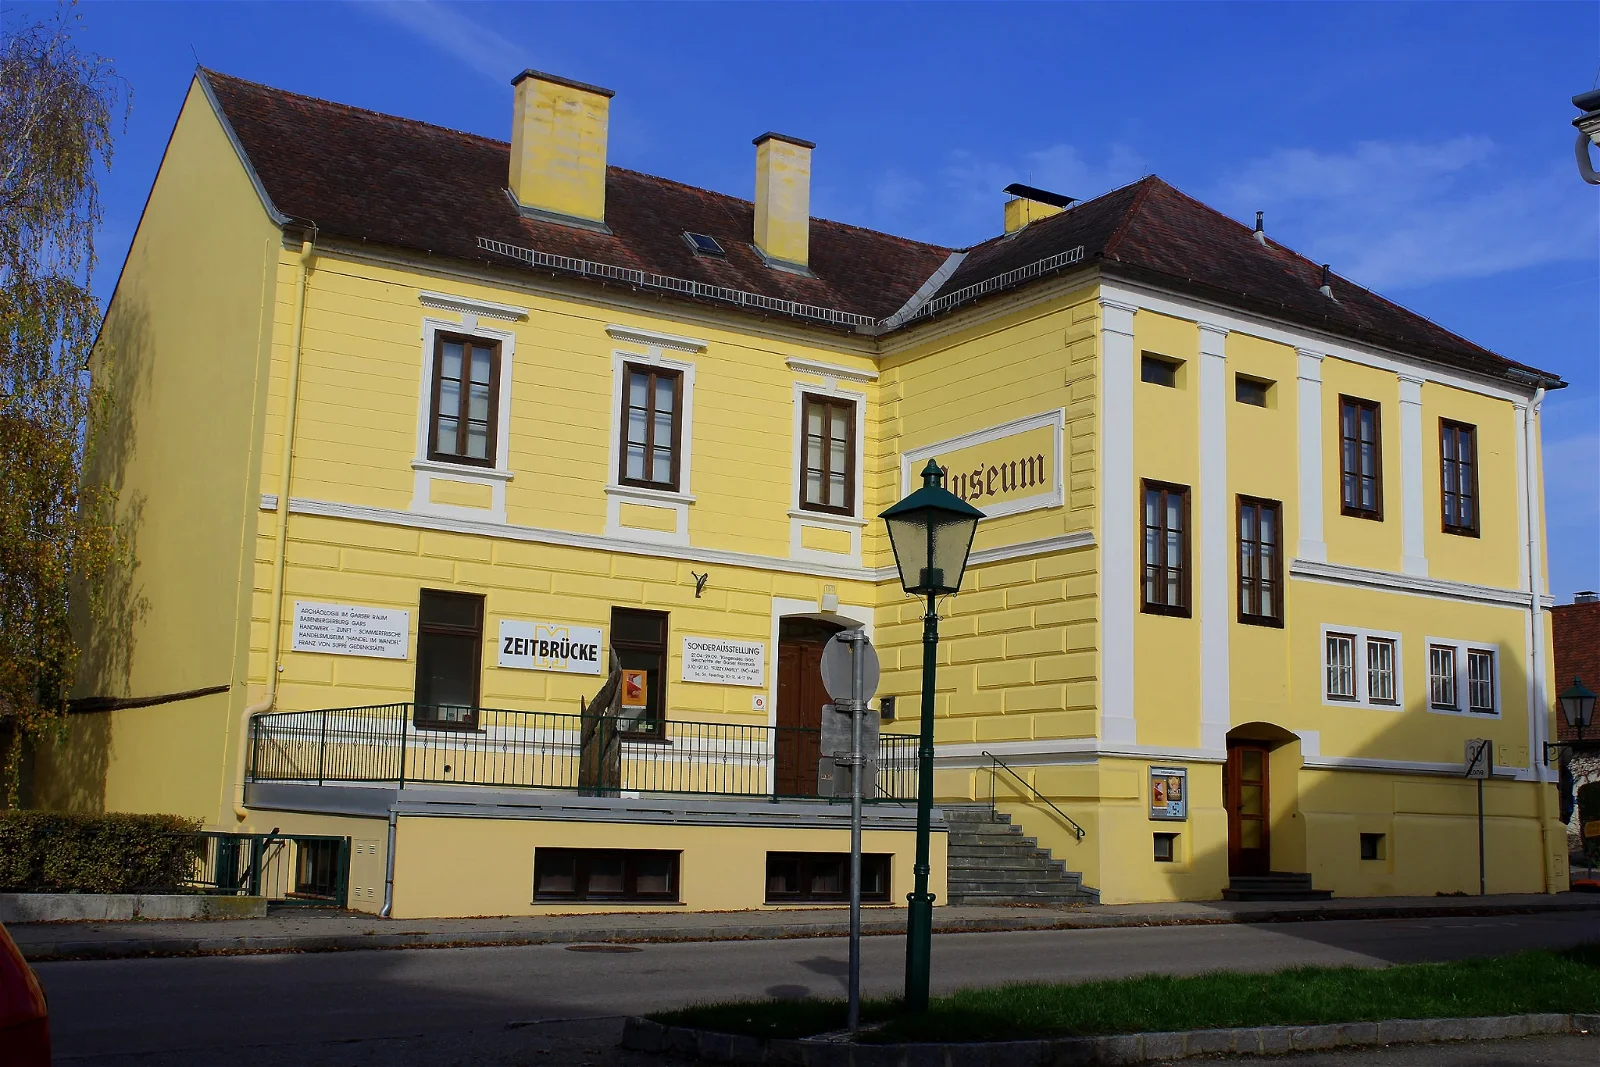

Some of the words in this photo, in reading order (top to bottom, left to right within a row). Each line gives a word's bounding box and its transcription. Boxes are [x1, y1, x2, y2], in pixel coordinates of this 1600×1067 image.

[941, 453, 1045, 501] useum
[504, 637, 598, 661] ZEITBRÜCKE
[688, 642, 760, 656] SONDERAUSSTELLUNG
[1469, 745, 1482, 762] 30
